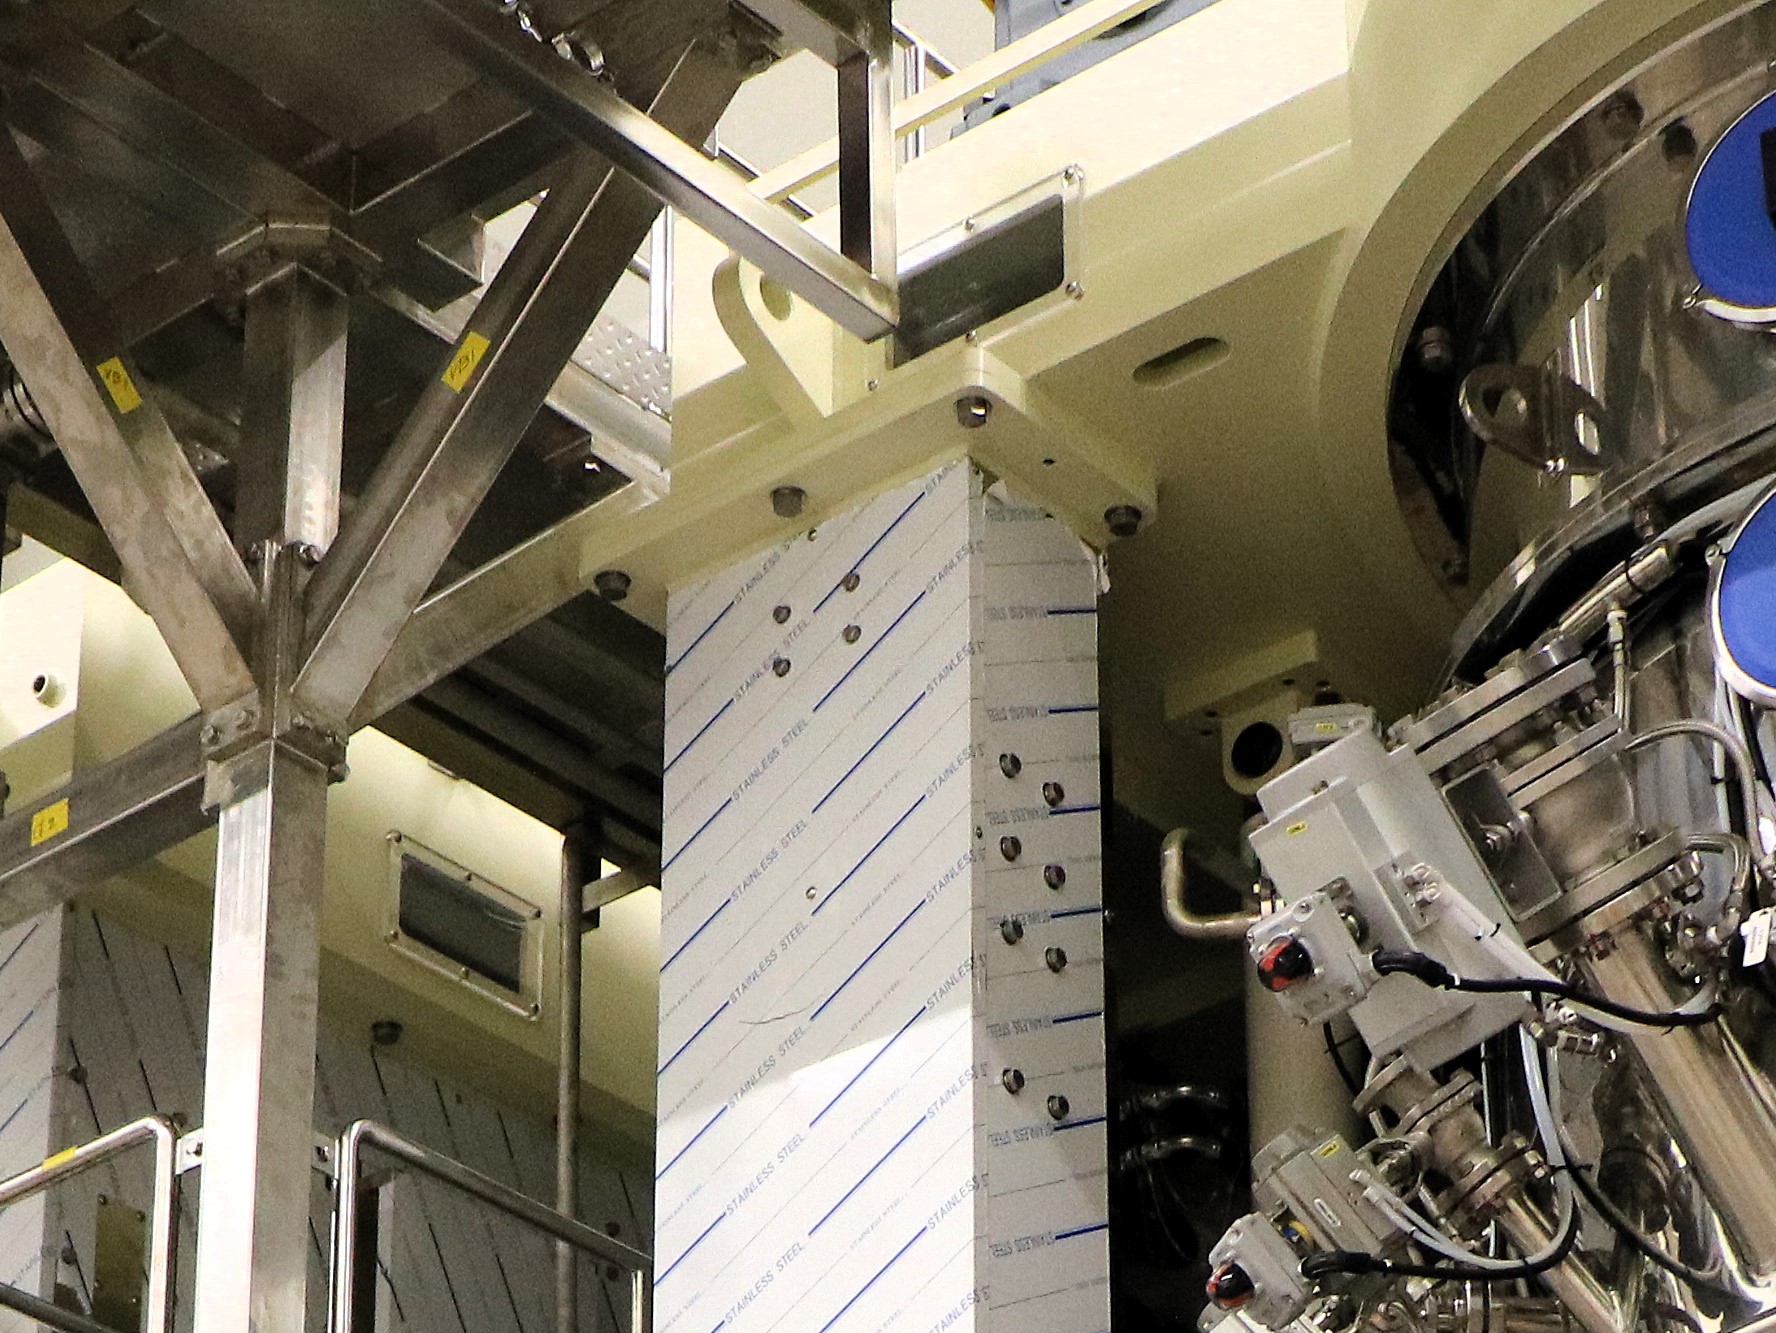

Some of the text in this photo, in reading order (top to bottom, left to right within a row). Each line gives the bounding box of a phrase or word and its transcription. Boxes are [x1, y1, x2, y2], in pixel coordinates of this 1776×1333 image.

[732, 712, 810, 802] STAINLESS STEEL
[730, 813, 809, 903] STAINLESS STEEL
[727, 1021, 809, 1110] STAINLESS STEEL
[727, 1128, 807, 1216] STAINLESS STEEL
